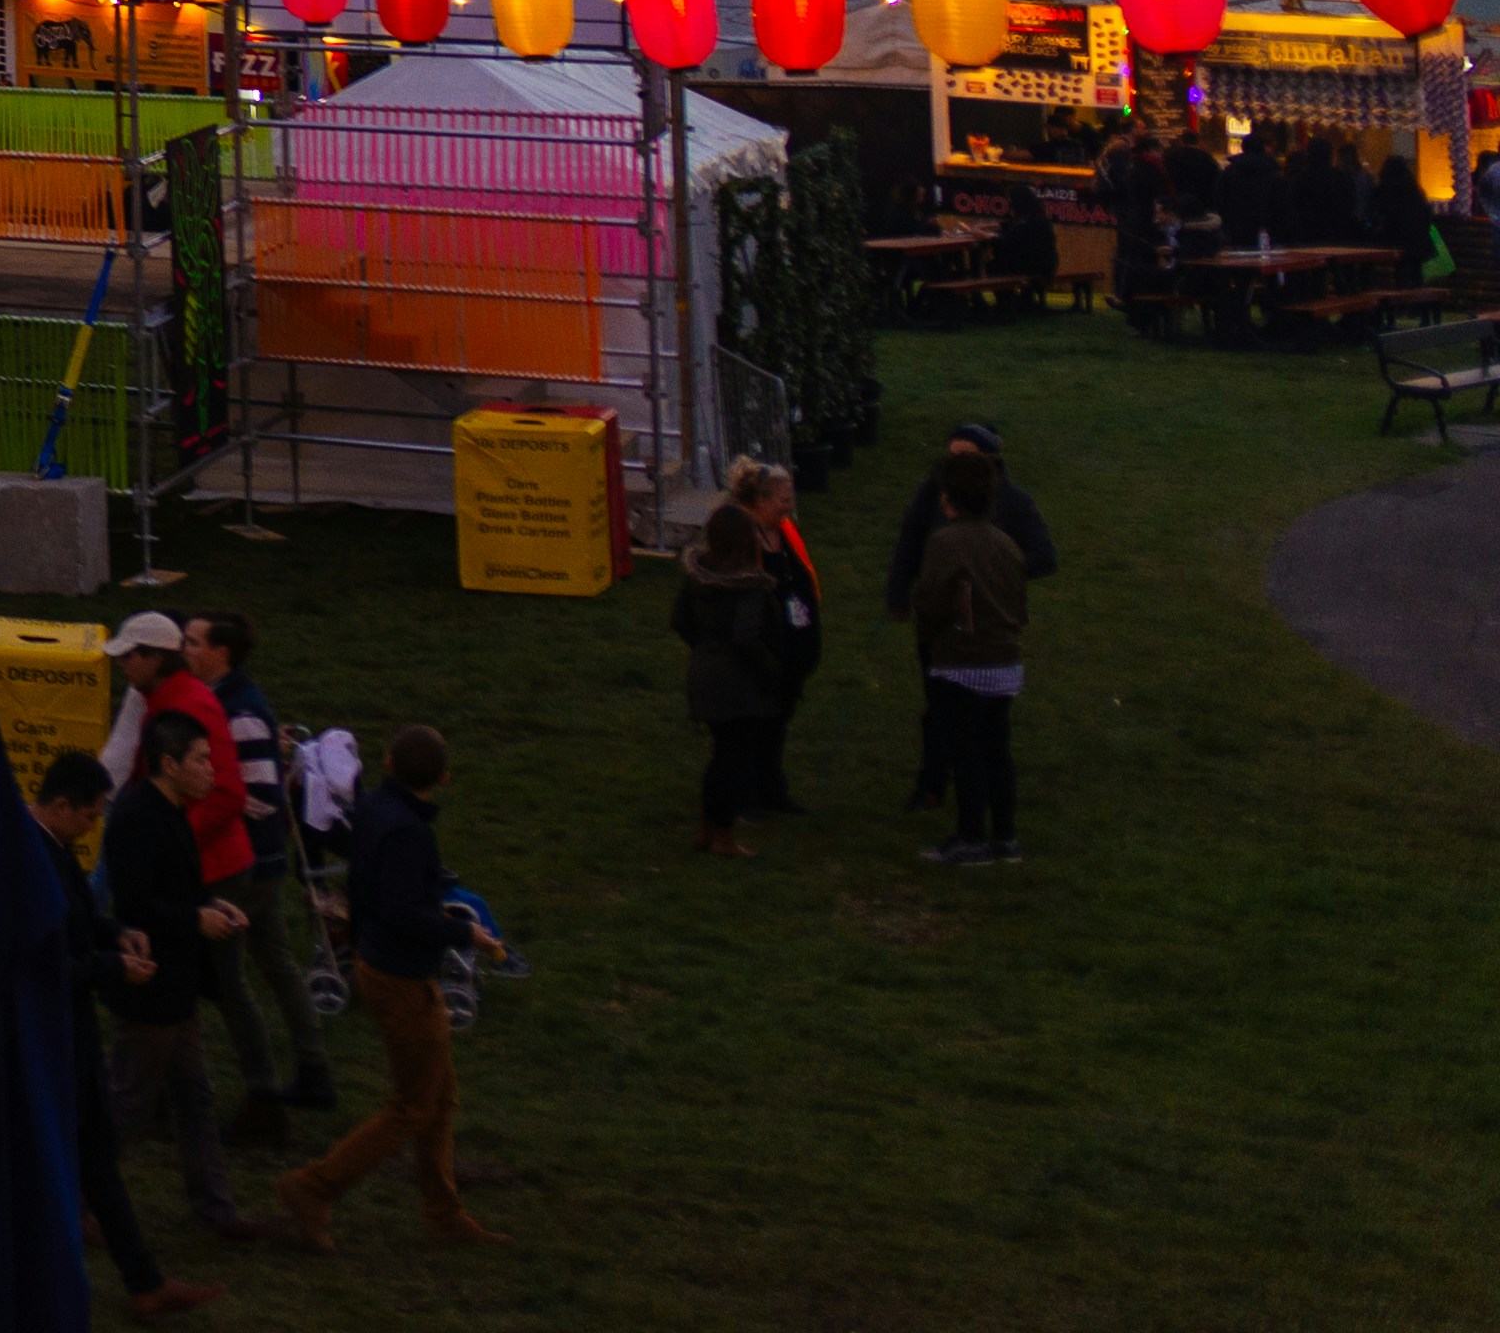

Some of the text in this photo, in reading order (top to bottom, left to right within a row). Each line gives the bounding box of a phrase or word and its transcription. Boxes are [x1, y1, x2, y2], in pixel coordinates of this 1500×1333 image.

[211, 50, 278, 77] FZZ
[500, 438, 571, 454] DEPOSITS
[475, 491, 571, 508] Plastic Bottles
[481, 507, 567, 524] Glass Bottles
[478, 523, 571, 539] Drink Cartons
[7, 664, 99, 687] DEPOSITS
[13, 719, 58, 736] Cans
